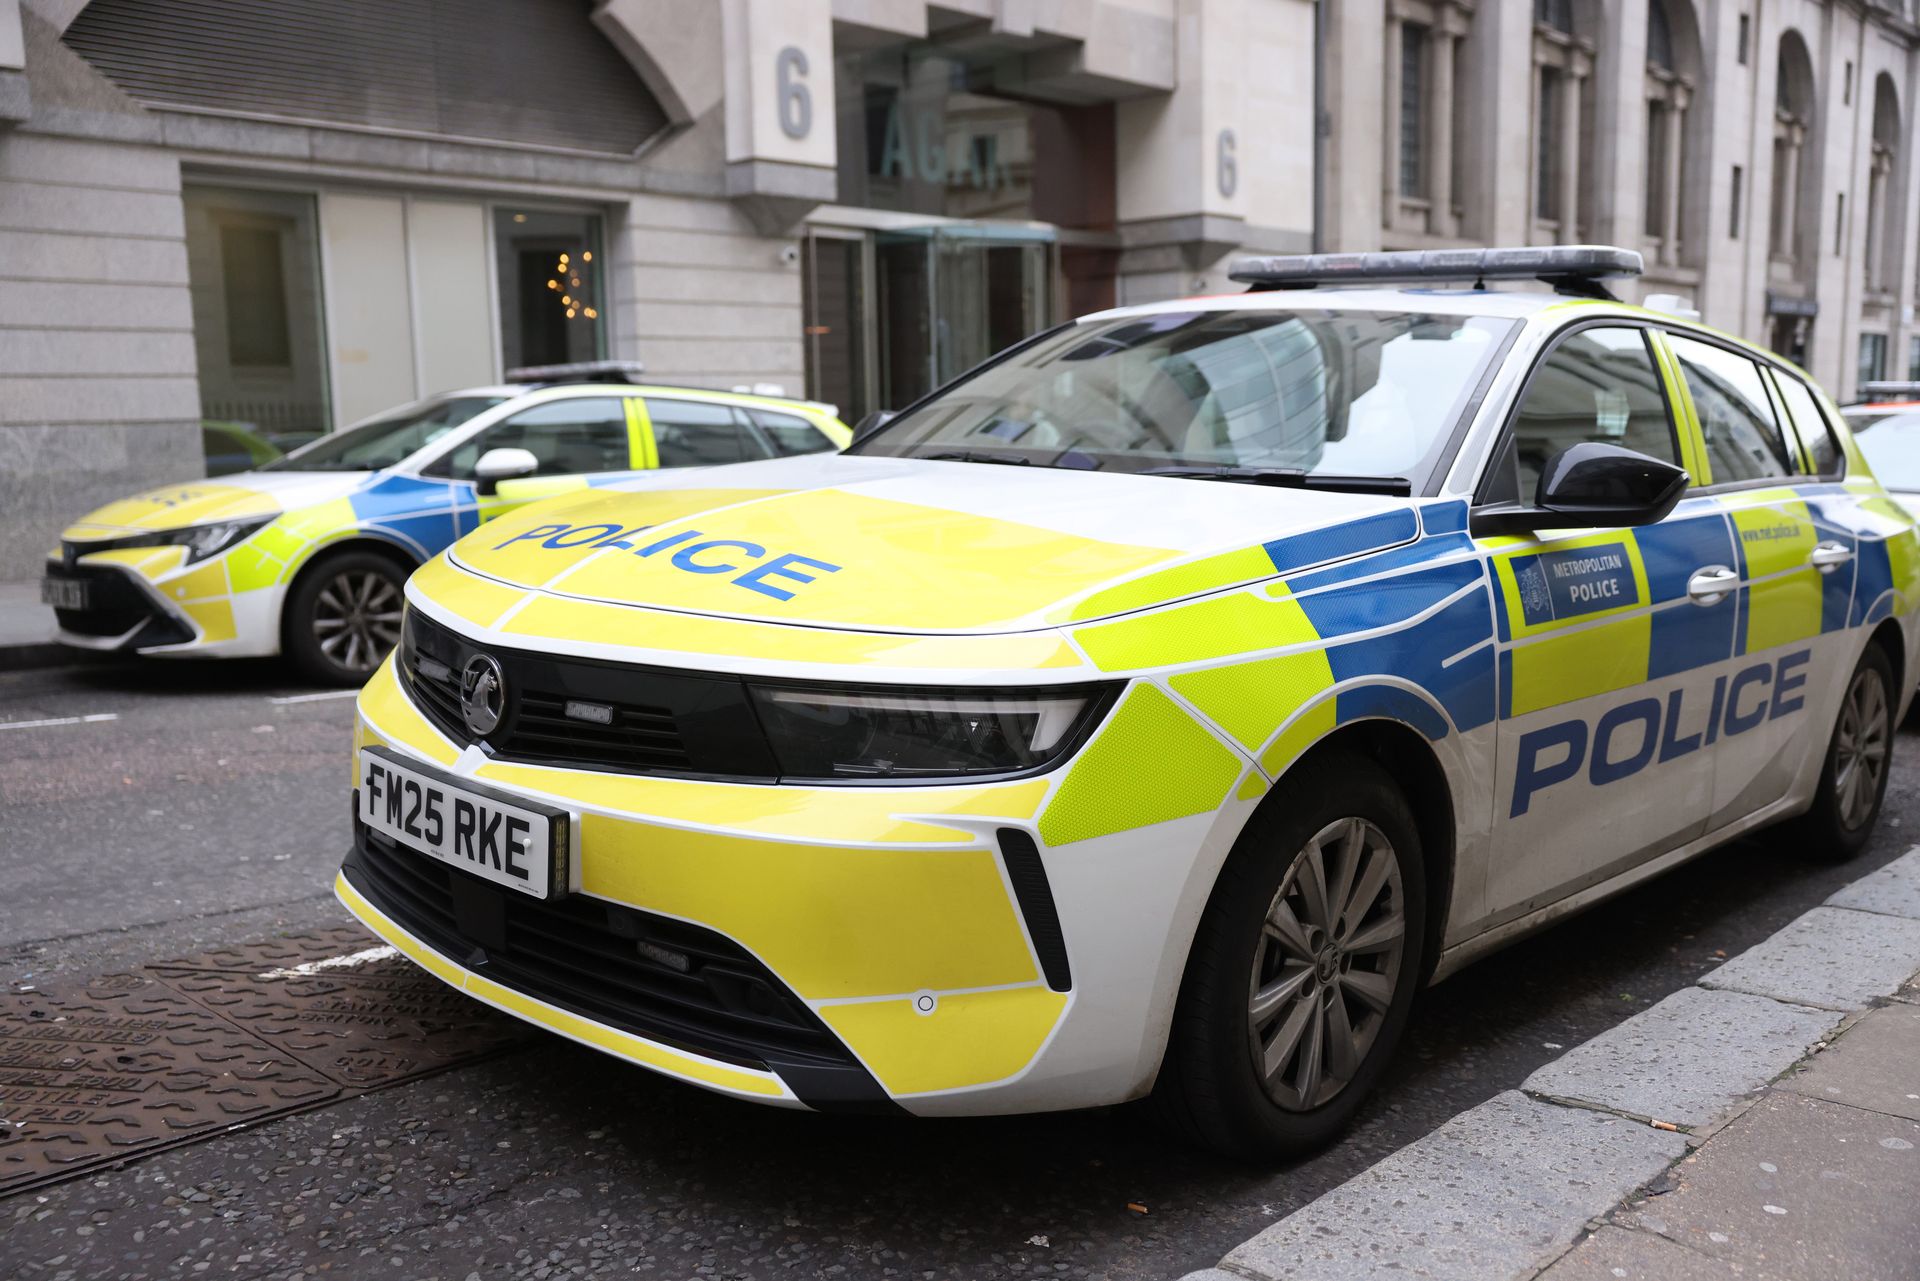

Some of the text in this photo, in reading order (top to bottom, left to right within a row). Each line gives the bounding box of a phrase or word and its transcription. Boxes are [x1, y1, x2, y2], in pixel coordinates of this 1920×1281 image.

[776, 45, 813, 139] 6
[1216, 127, 1237, 199] 6
[492, 523, 843, 602] POLICE
[1552, 554, 1623, 579] METROPOLITAN
[1569, 578, 1620, 603] POLICE
[1509, 648, 1811, 819] POLICE
[369, 762, 530, 881] FM25 RKE
